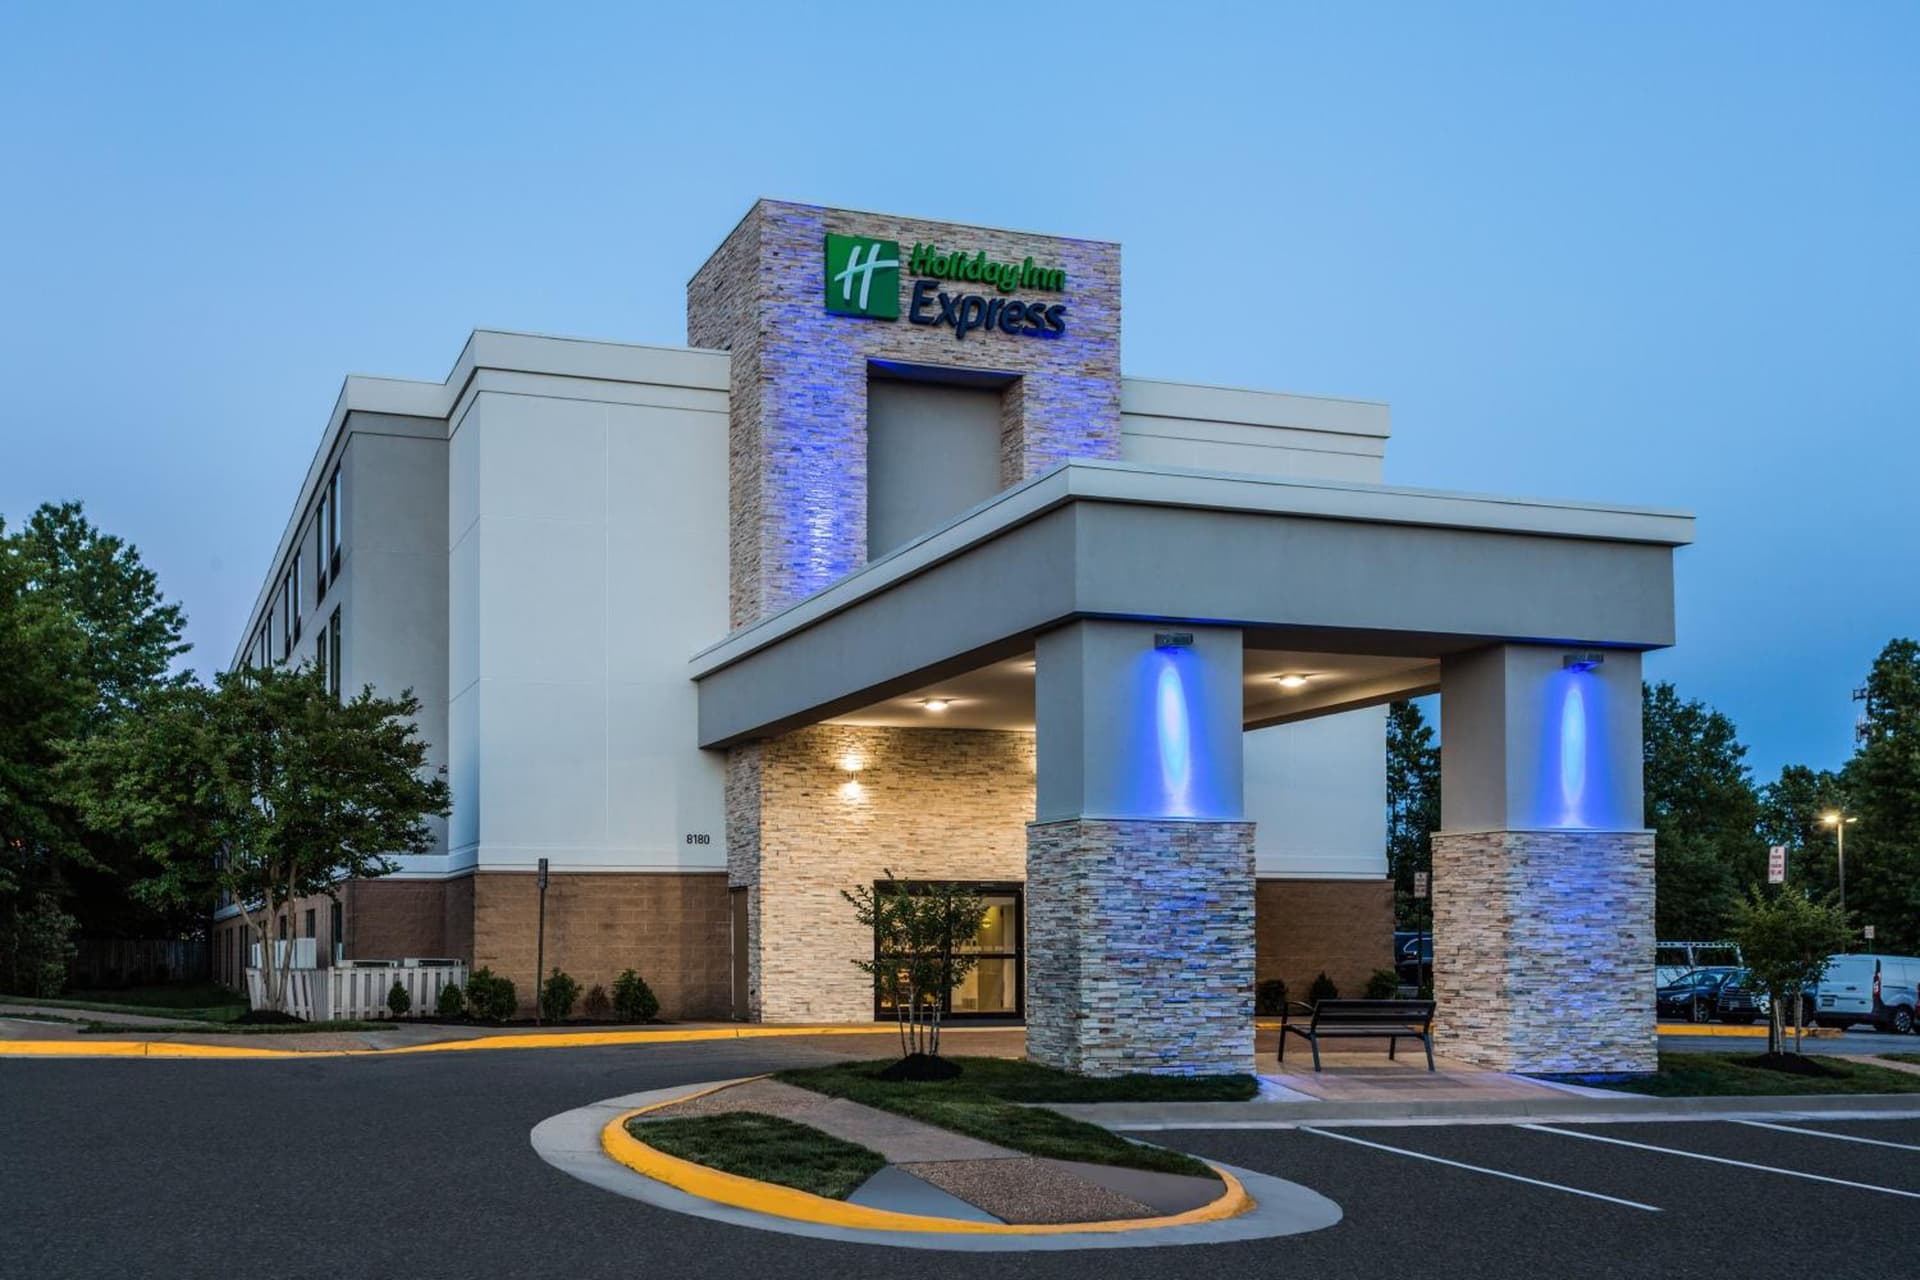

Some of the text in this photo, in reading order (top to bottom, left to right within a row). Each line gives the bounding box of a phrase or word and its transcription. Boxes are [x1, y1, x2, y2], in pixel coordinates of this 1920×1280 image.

[909, 242, 1065, 292] Holiday Inn
[909, 280, 1066, 339] Express
[686, 833, 710, 845] 8180
